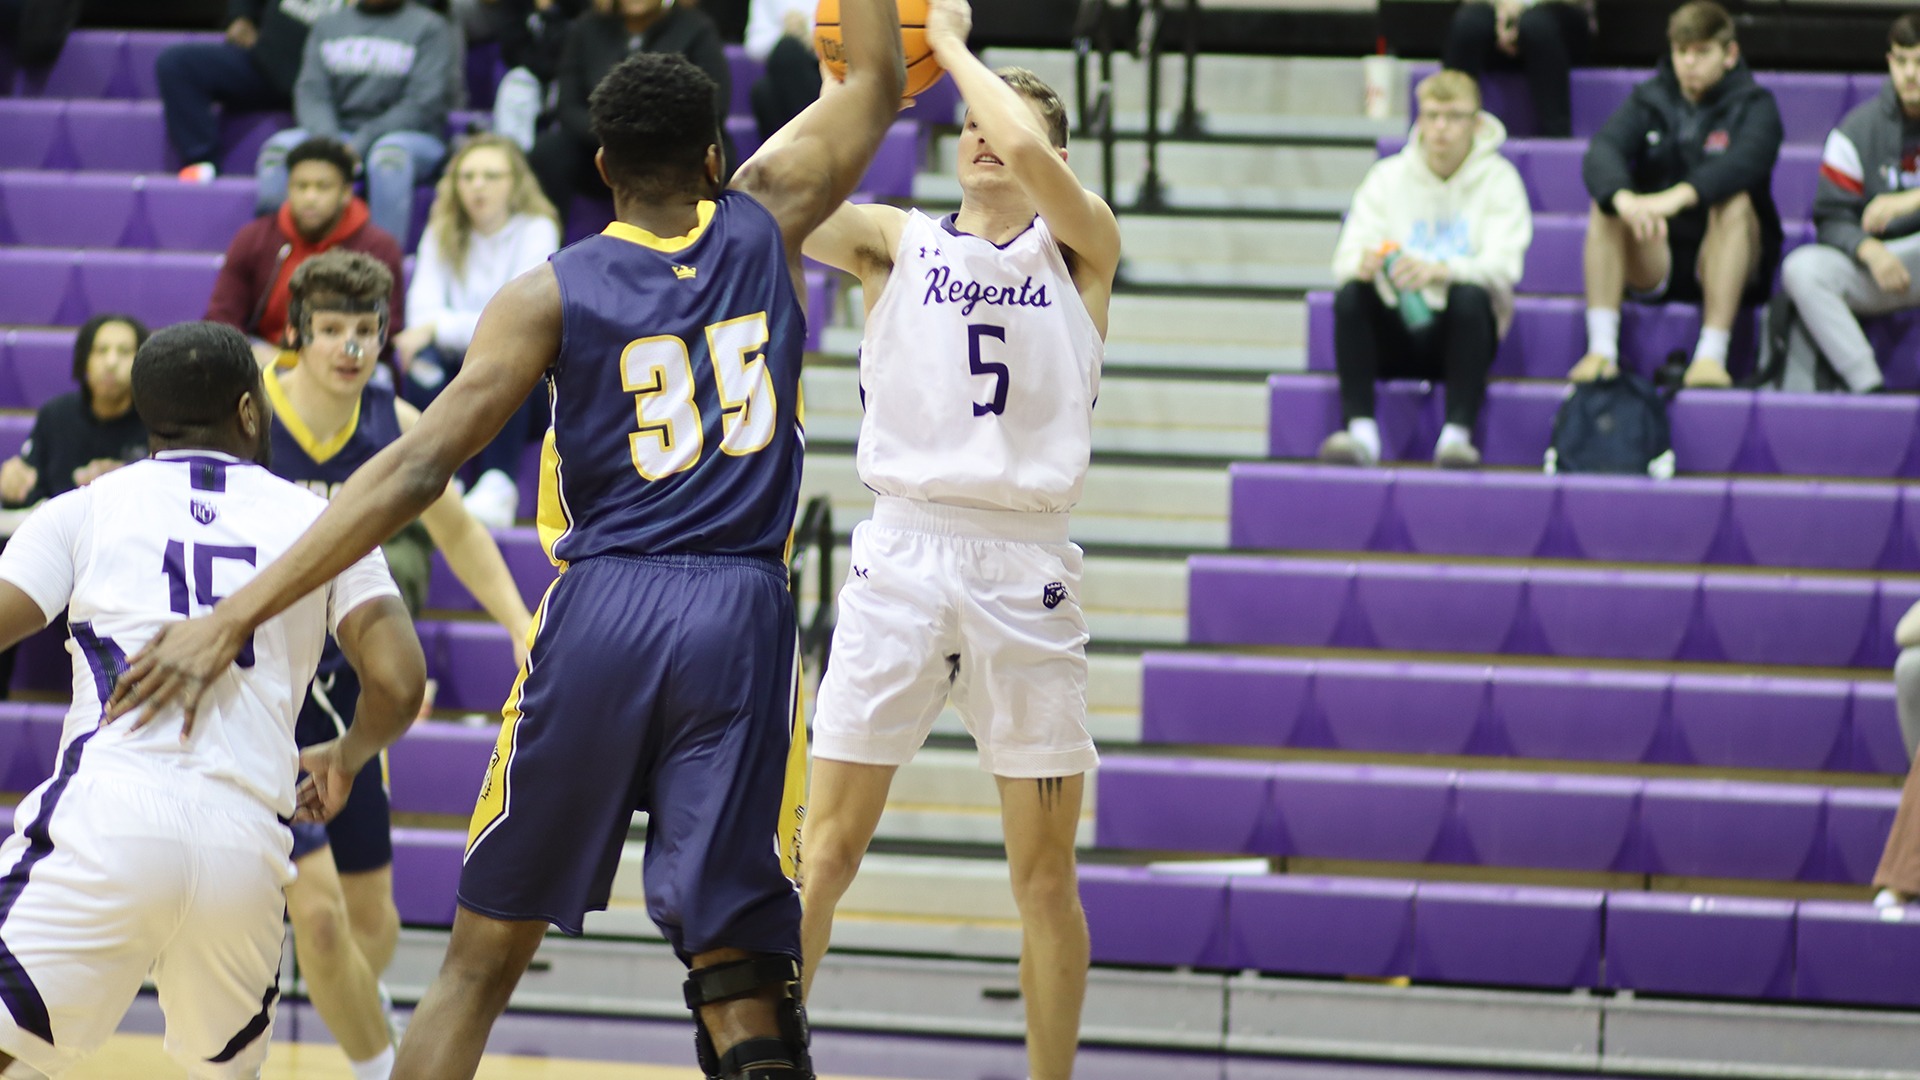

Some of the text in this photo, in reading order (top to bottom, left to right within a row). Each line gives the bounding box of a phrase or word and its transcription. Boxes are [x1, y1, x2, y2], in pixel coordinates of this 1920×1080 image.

[923, 265, 1052, 316] Regents
[619, 310, 778, 482] 35
[967, 323, 1010, 417] 5
